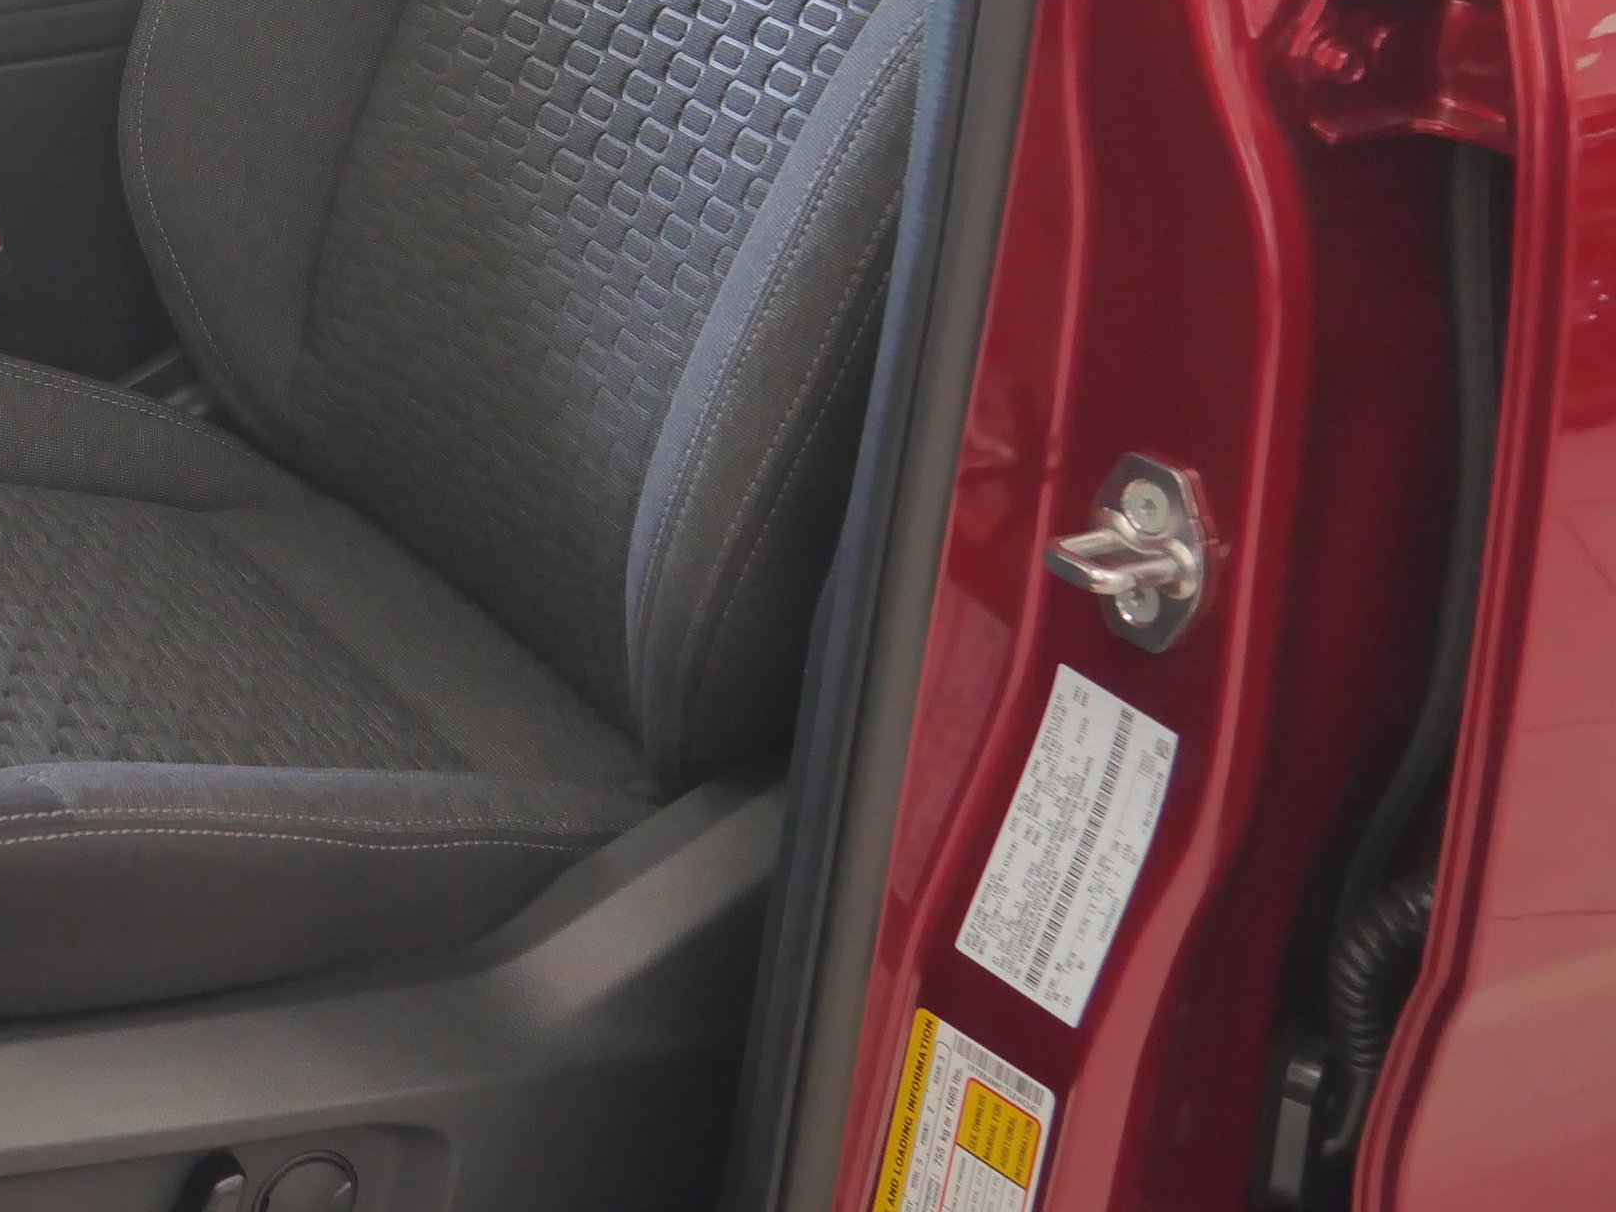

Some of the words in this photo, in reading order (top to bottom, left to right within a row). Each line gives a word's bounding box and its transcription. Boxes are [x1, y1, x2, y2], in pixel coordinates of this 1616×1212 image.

[906, 1017, 934, 1114] INFORMATION
[893, 1116, 914, 1176] LOADING
[941, 1129, 952, 1143] kg
[982, 1122, 997, 1161] MANUAL
[999, 1116, 1018, 1169] ADDITIONAL
[888, 1175, 900, 1207] AND
